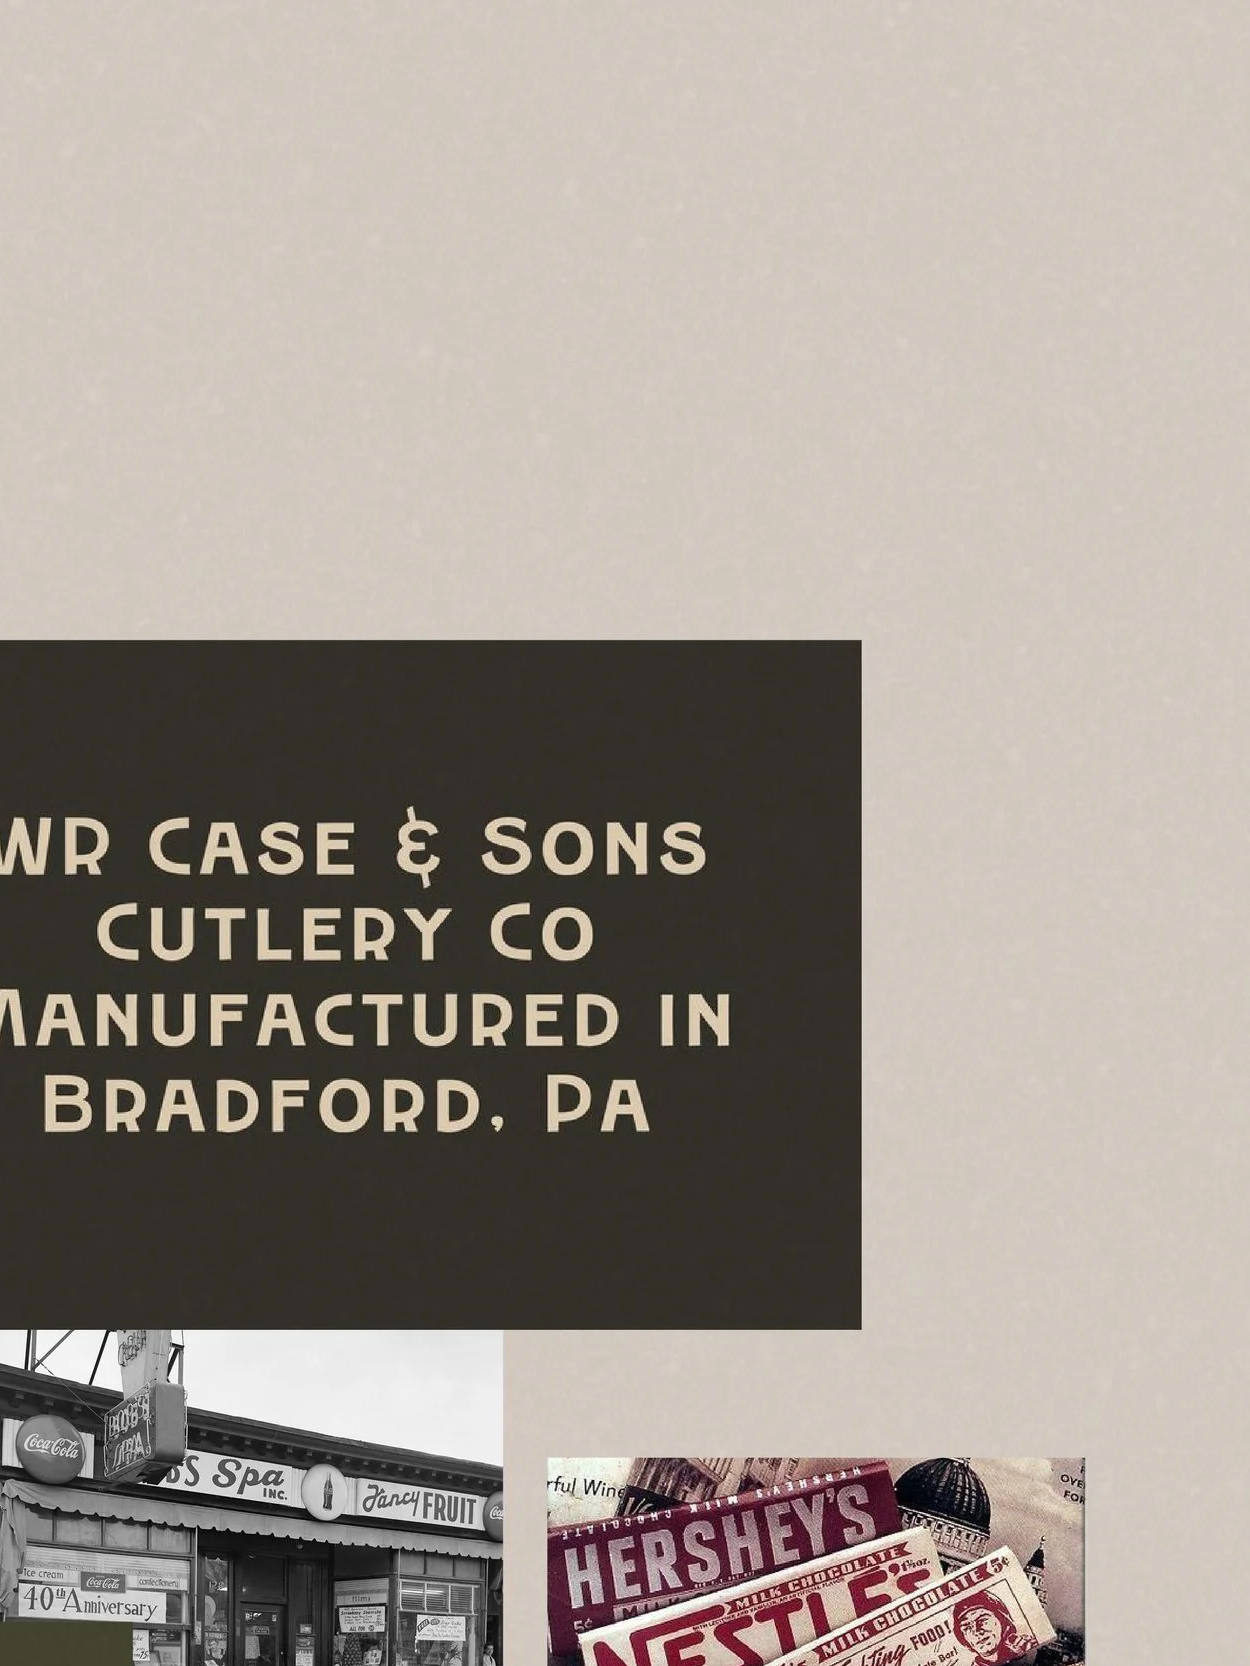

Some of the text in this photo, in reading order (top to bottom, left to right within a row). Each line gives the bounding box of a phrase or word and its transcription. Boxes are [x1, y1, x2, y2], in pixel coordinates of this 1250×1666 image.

[148, 815, 356, 877] CASE
[395, 805, 442, 889] &
[481, 815, 707, 877] SONS
[96, 901, 595, 962] CUTLERY CO
[658, 992, 732, 1048] IN
[42, 1073, 651, 1134] BRADFORD, PA
[212, 1457, 286, 1496] Spa
[262, 1486, 289, 1501] INC.
[362, 1482, 421, 1518] Fancy
[421, 1490, 477, 1526] FRUIT
[23, 1567, 65, 1580] ice cream
[563, 1483, 877, 1610] HERSHEY'S
[989, 1555, 1010, 1574] 5¢
[735, 1586, 782, 1611] MILK
[787, 1545, 901, 1592] CHOCOLATE
[822, 1626, 870, 1658] MILK
[873, 1568, 983, 1632] CHOCOLATE
